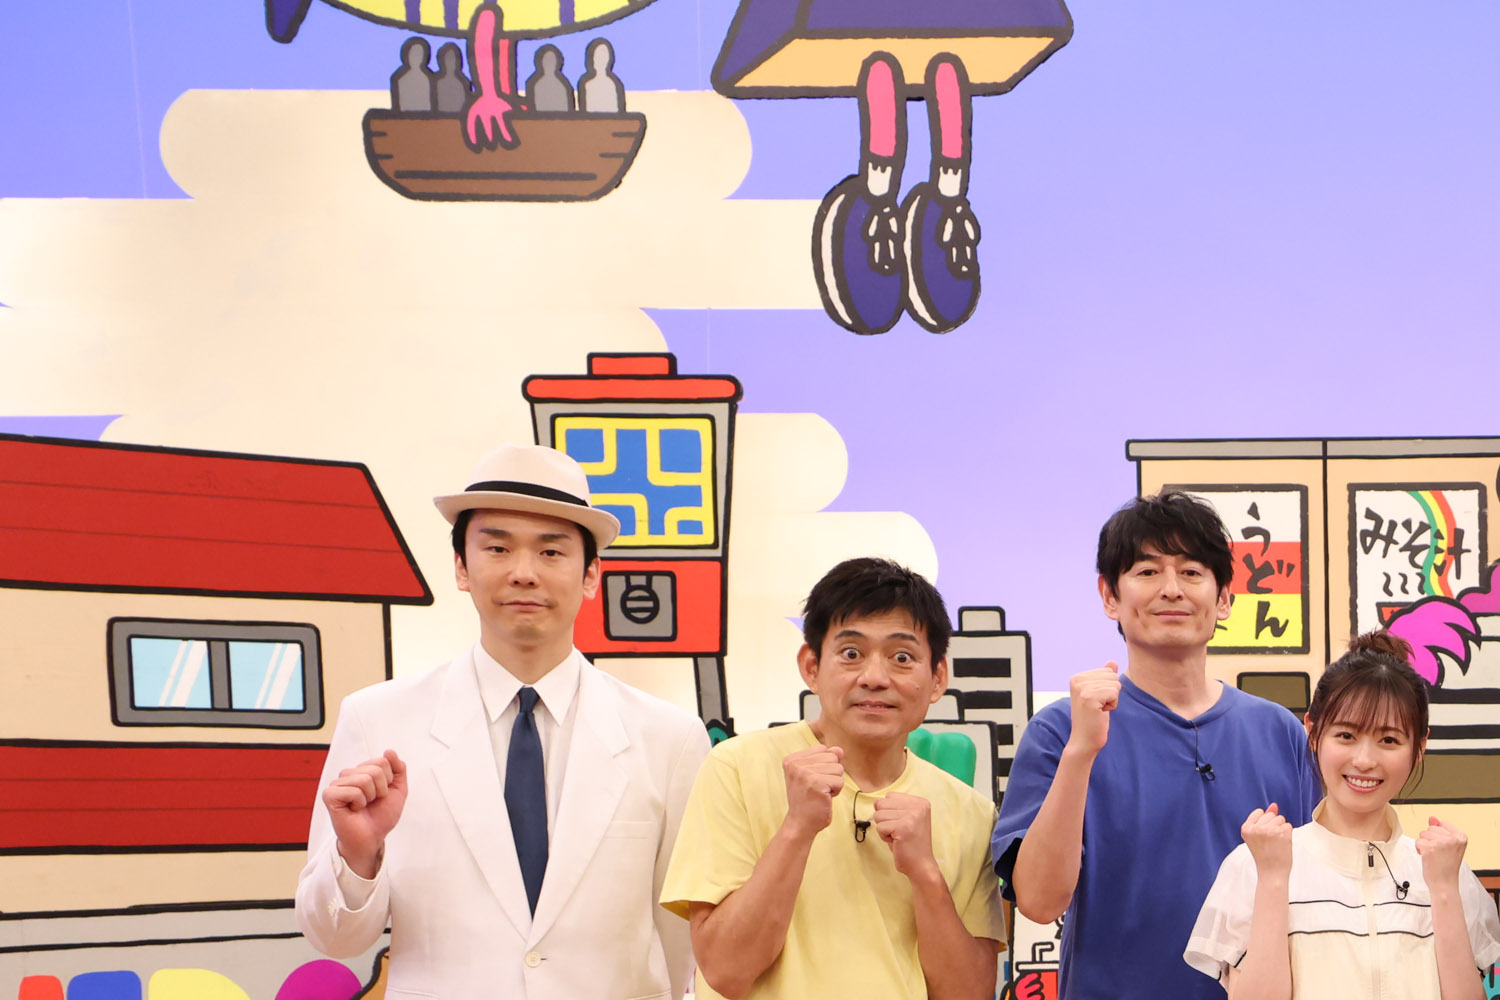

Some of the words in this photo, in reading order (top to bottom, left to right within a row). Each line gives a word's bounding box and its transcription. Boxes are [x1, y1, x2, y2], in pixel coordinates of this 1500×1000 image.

[1241, 501, 1295, 640] うどん
[1359, 507, 1472, 580] みそ汁
